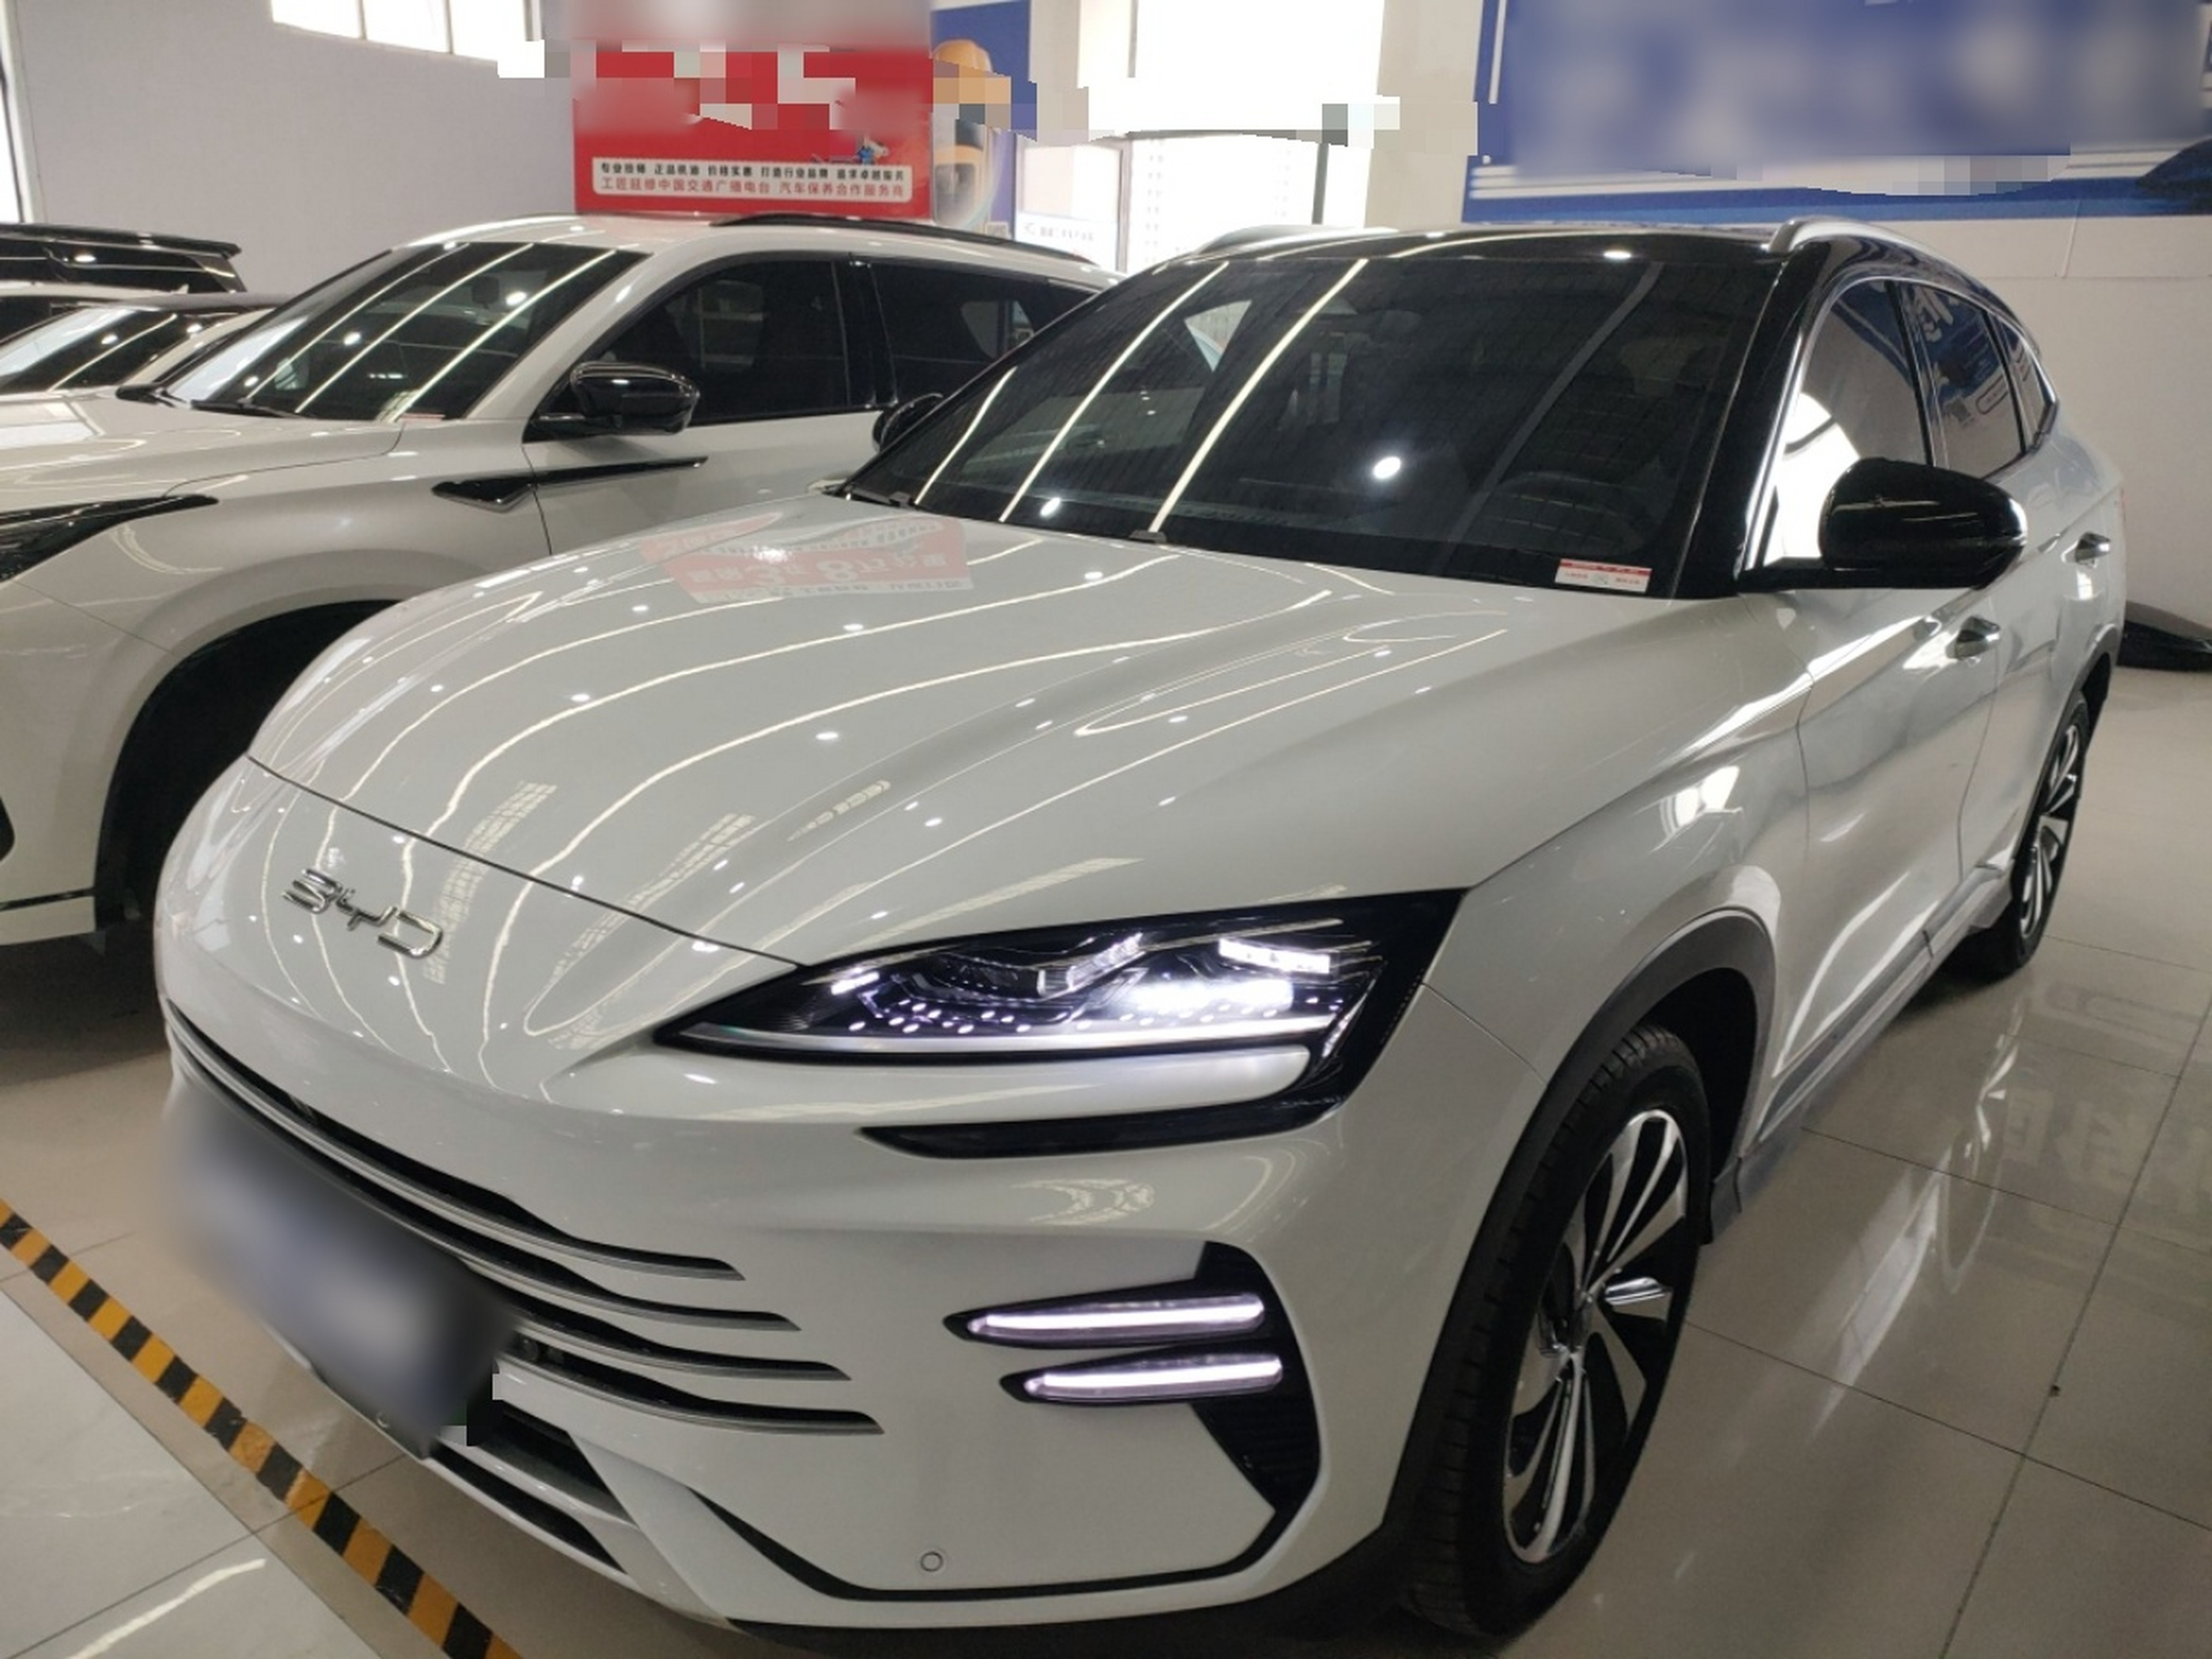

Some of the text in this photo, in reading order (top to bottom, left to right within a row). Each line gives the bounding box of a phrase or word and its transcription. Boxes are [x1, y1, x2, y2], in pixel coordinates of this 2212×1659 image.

[601, 162, 646, 174] 专业技师
[708, 165, 752, 177] 价格实惠
[760, 166, 828, 179] 打造行业品牌
[837, 168, 904, 181] 追求卓越服务
[283, 868, 444, 960] BYD
